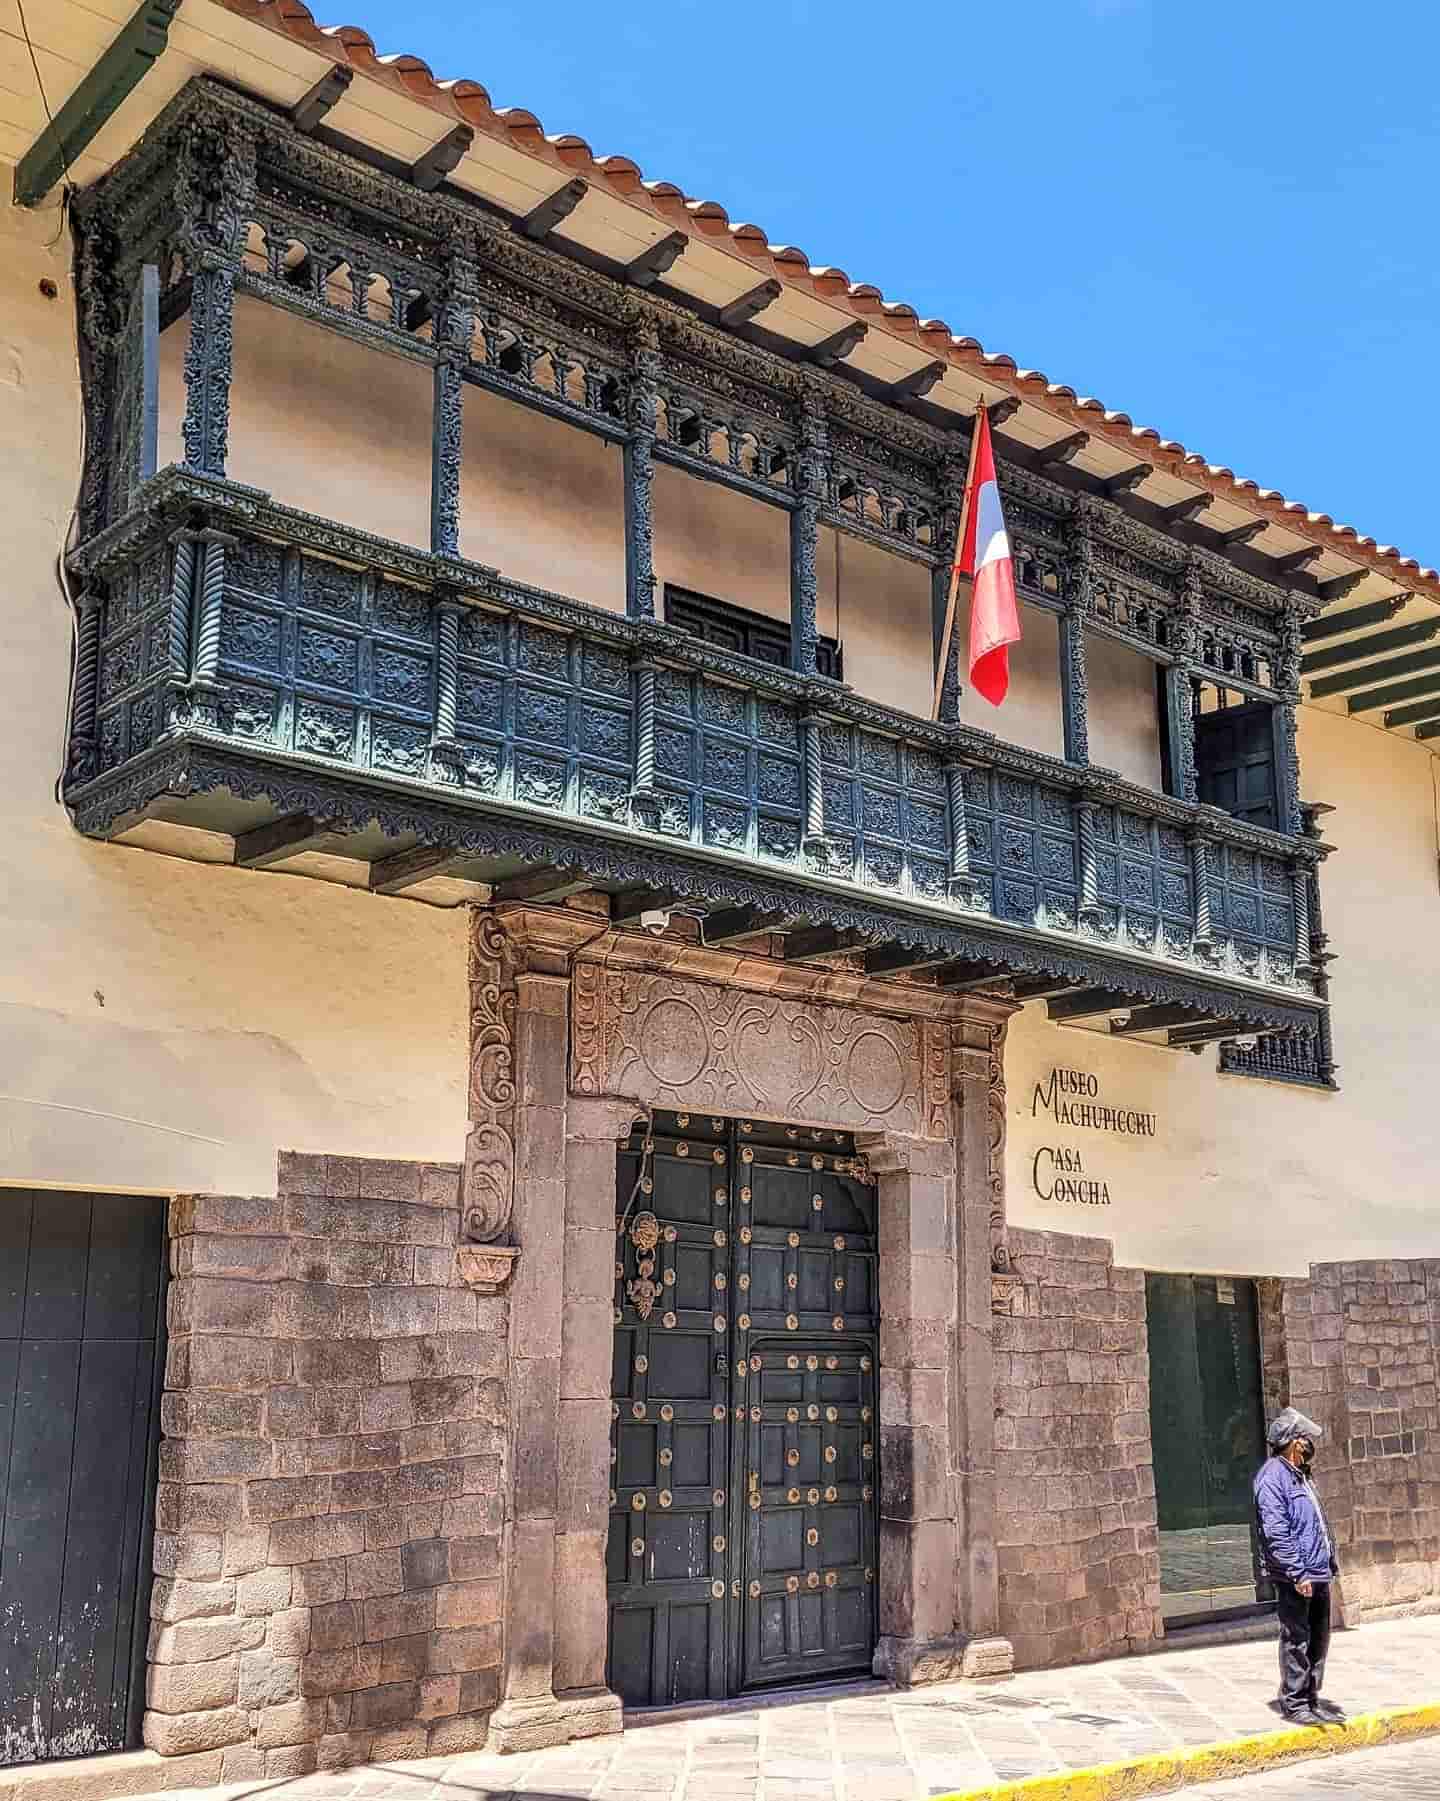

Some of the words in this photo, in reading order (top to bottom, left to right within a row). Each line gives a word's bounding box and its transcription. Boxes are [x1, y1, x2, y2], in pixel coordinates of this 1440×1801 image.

[1032, 1067, 1098, 1124] MUSEO
[1033, 1147, 1084, 1201] CASA
[1033, 1147, 1111, 1205] CONCHA
